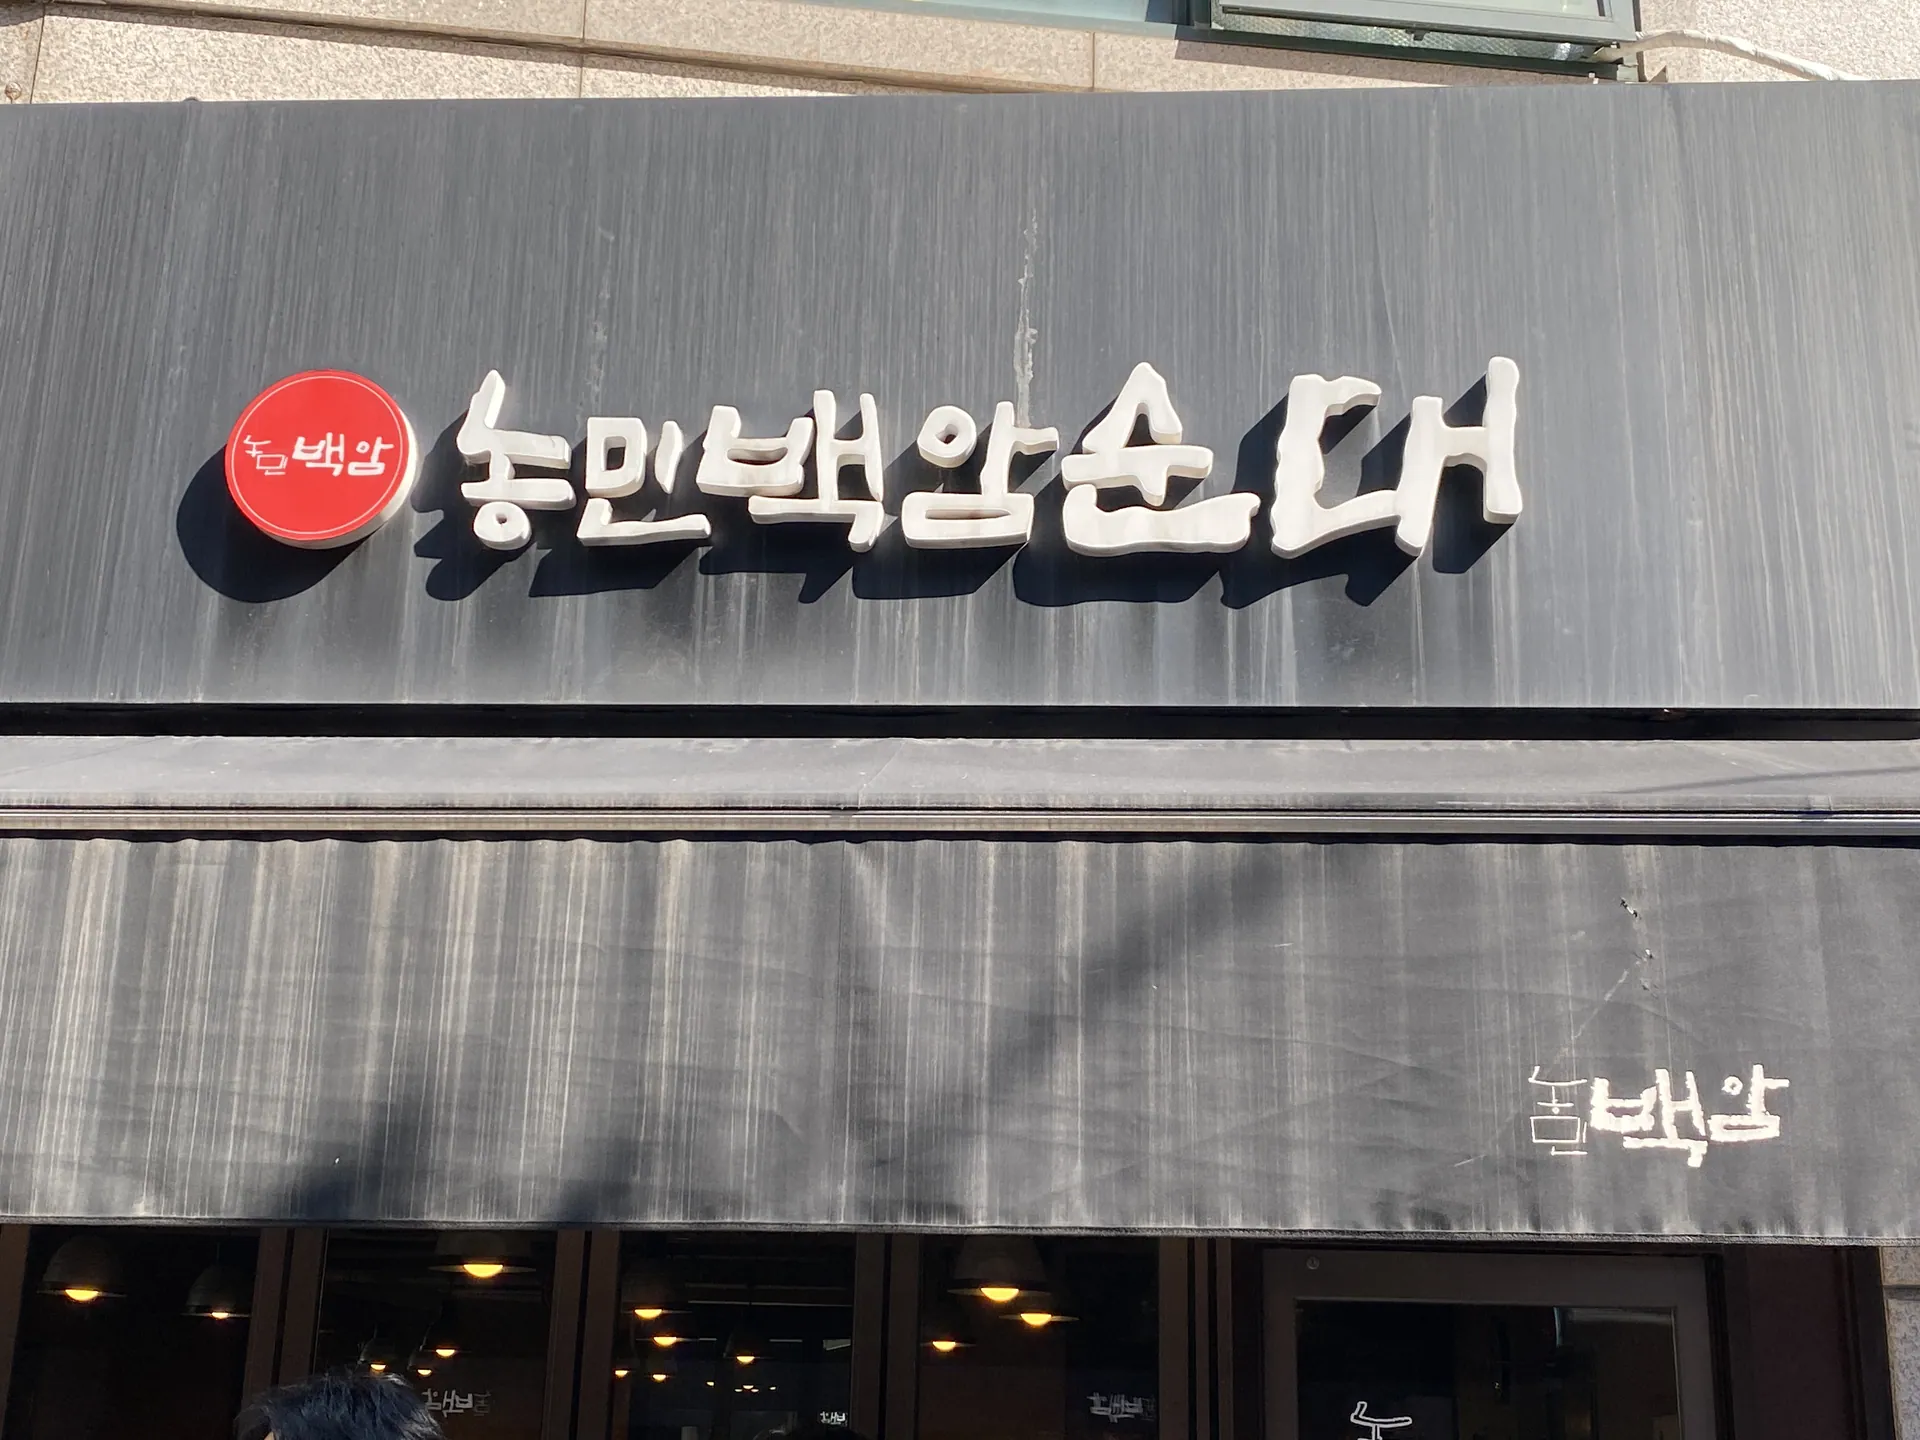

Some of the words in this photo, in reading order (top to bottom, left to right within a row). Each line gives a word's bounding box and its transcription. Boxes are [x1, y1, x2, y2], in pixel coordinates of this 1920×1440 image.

[292, 432, 394, 477] 백암
[457, 356, 1523, 558] 농민백암순대
[1590, 1063, 1790, 1168] 백암
